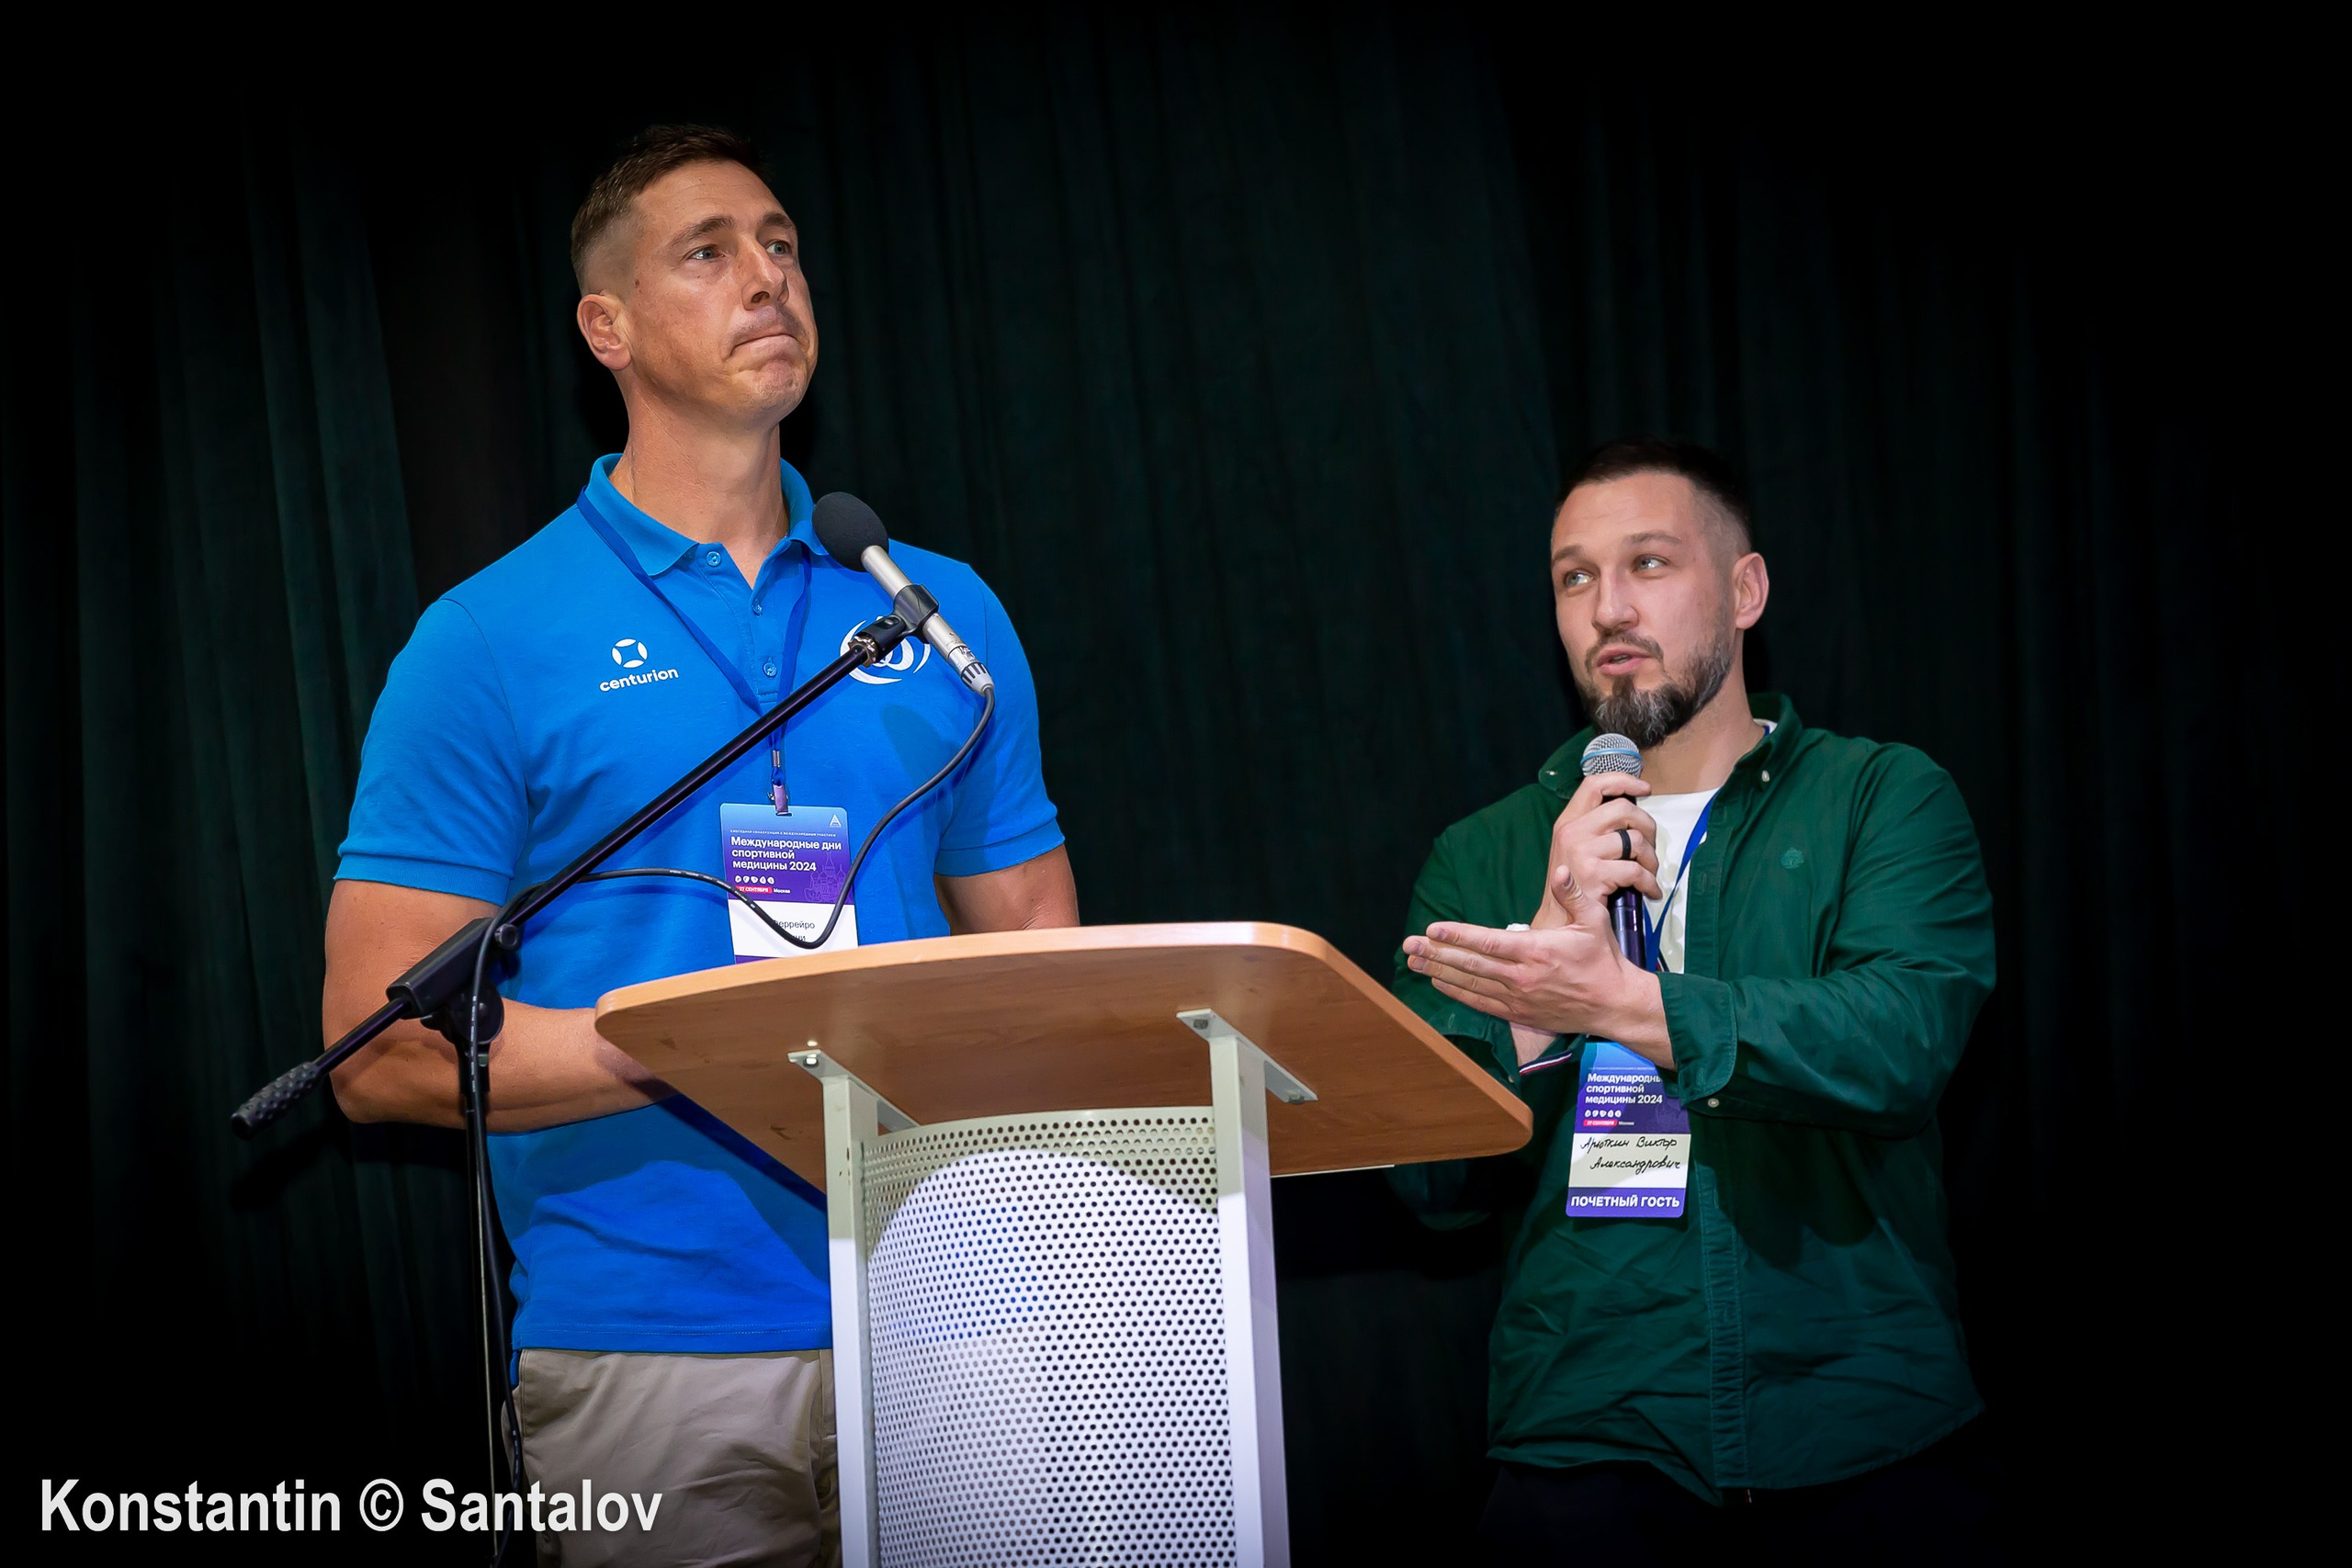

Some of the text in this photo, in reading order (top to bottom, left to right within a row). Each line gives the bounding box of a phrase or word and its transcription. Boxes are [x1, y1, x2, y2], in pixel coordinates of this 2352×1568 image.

[599, 668, 679, 692] centurion
[730, 836, 842, 852] Международные дни
[731, 849, 795, 861] спортивной
[732, 861, 817, 872] медицины 2024
[1586, 1084, 1645, 1095] спортивной
[1585, 1094, 1663, 1105] медицины 2024
[1635, 1135, 1678, 1150] Виктор
[1589, 1155, 1681, 1175] Александрович
[1570, 1194, 1680, 1208] ПОЧЕТНЫЙ ГОСТЬ
